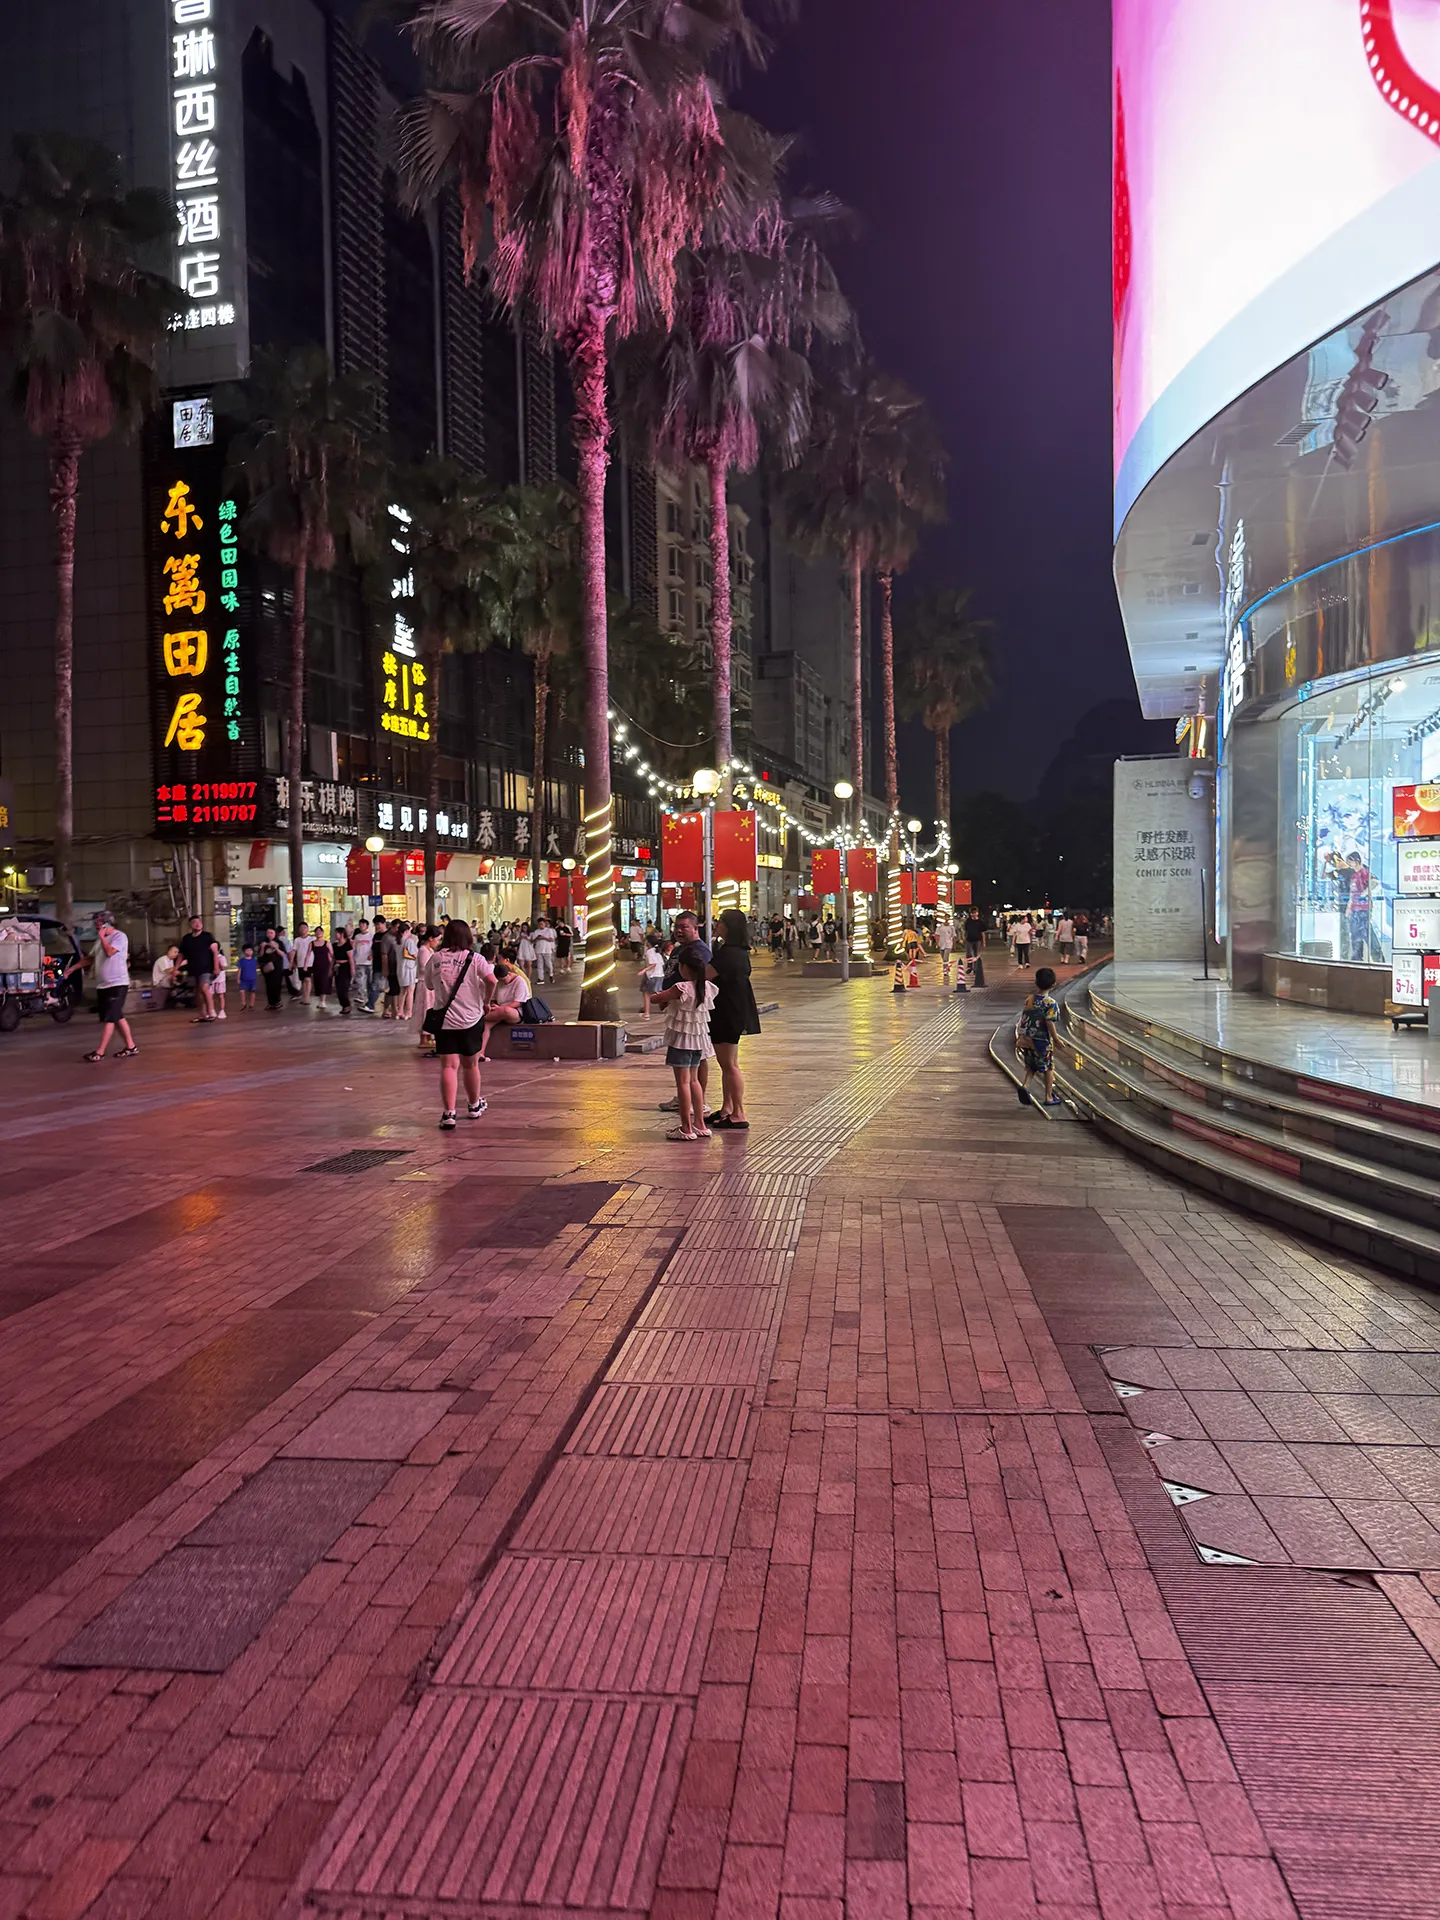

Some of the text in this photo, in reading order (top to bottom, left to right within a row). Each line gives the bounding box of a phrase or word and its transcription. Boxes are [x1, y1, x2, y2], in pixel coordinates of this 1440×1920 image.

[159, 479, 208, 751] 东篱田居
[218, 500, 242, 741] 绿色田园味 原生自然香
[156, 781, 257, 803] 本座 2119977
[156, 804, 257, 823] 二楼 2119787
[1133, 846, 1196, 862] 灵感不设限
[1136, 867, 1192, 878] COMING SOON
[1409, 923, 1418, 938] 5
